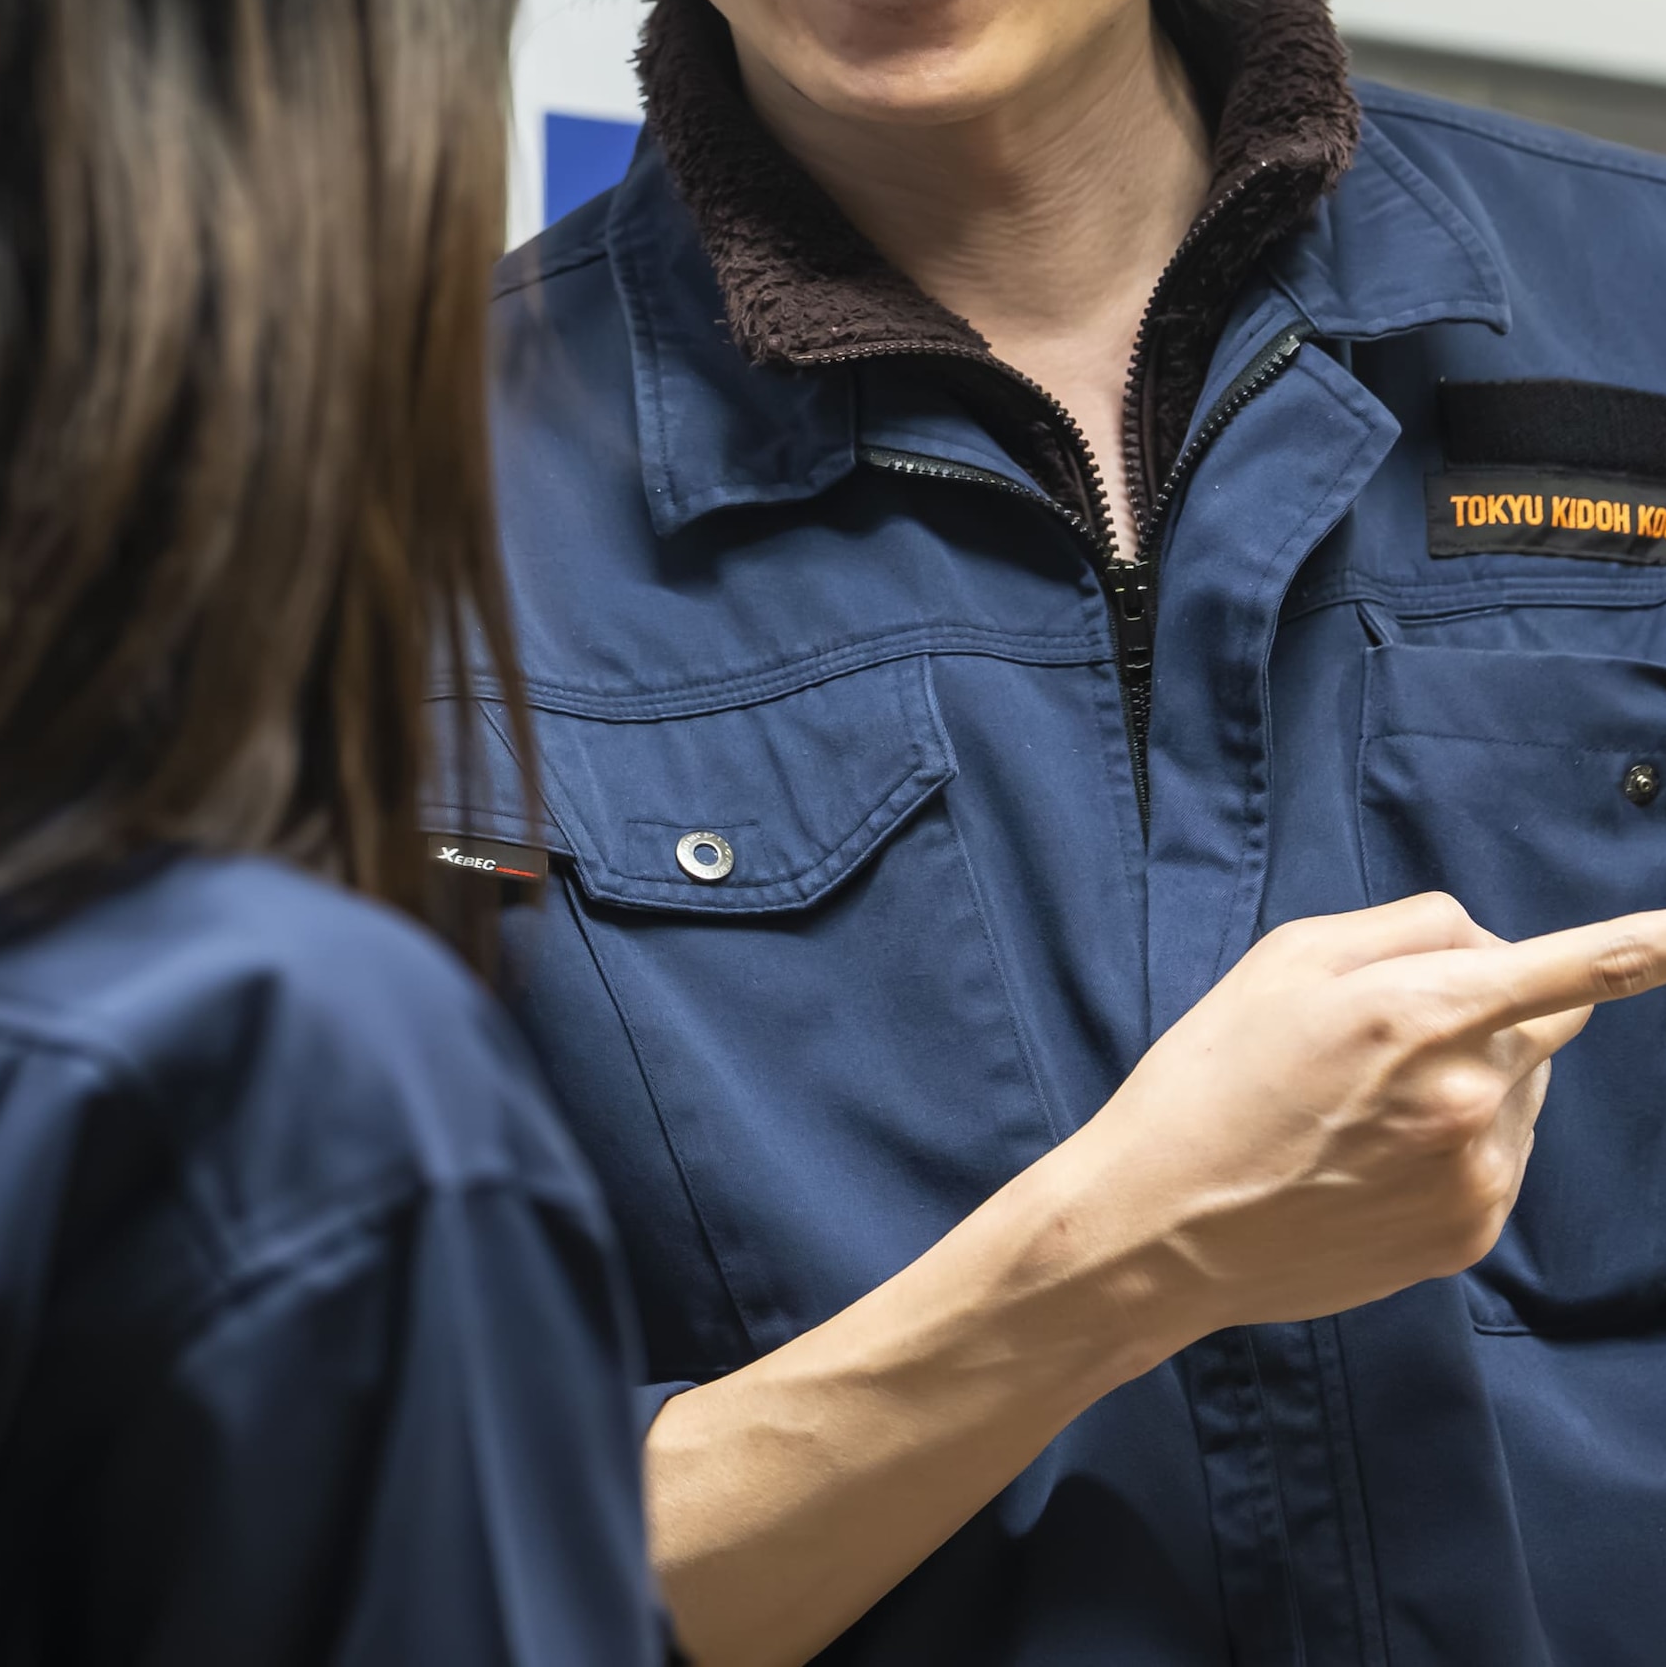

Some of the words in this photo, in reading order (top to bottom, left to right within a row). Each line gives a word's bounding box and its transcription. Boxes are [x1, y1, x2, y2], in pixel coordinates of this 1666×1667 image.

[1450, 494, 1544, 527] TOKYU
[1551, 496, 1631, 534] KIDOH
[437, 846, 497, 872] XEBEC
